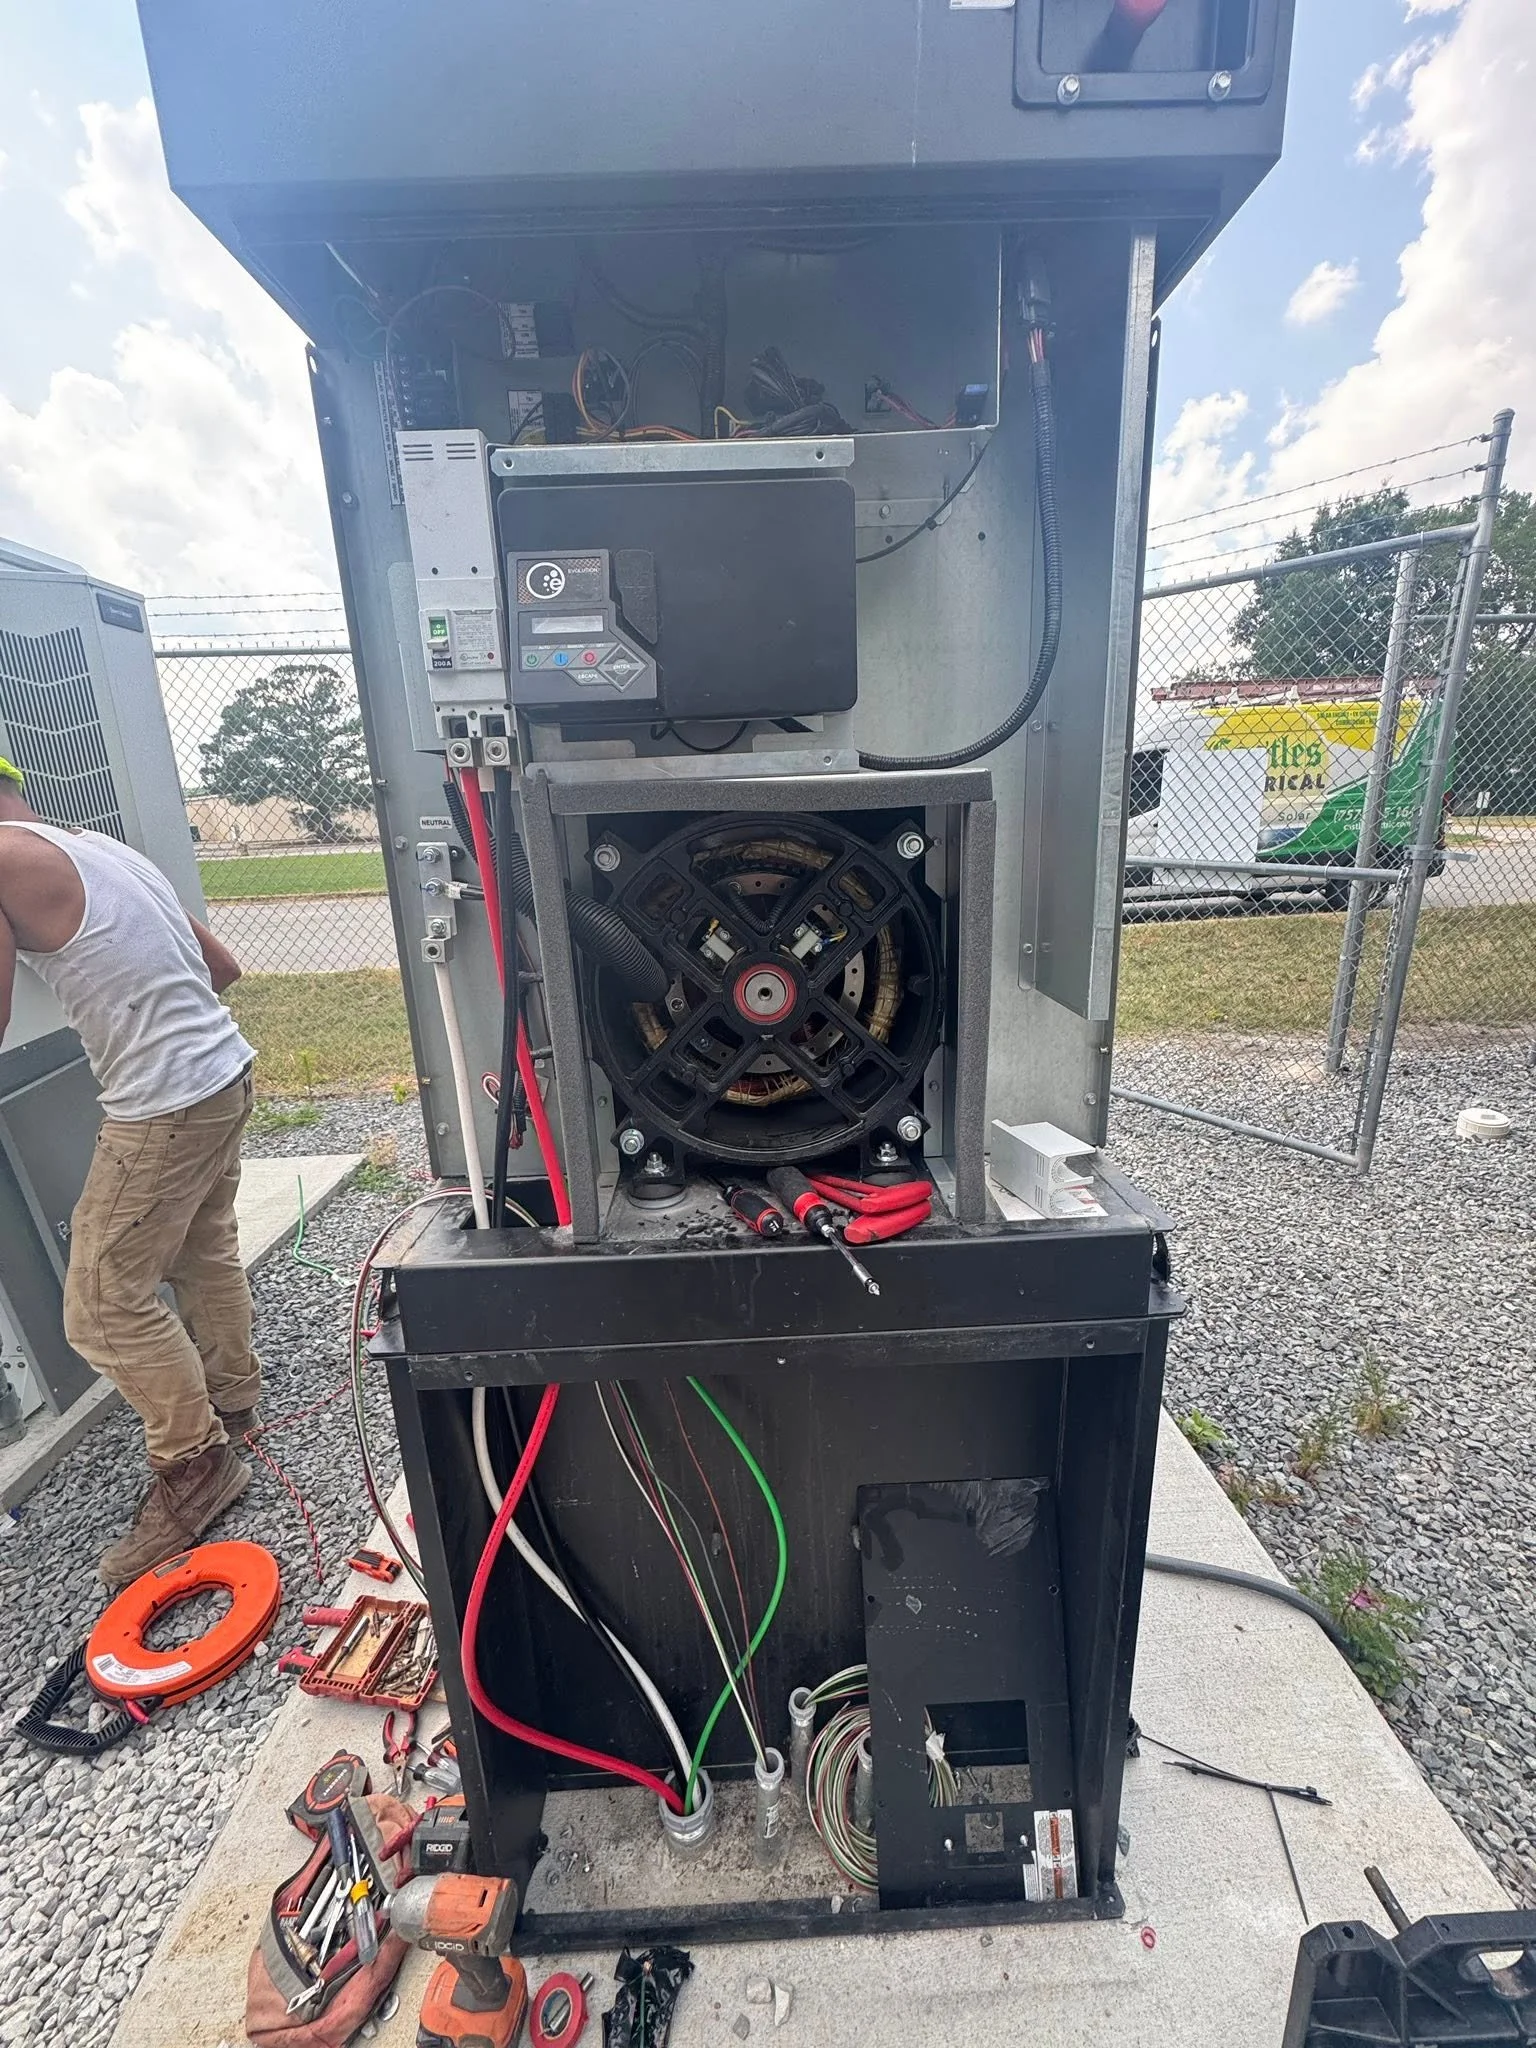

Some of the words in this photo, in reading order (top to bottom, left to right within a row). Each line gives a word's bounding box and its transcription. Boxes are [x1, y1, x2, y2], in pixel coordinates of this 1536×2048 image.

[1264, 774, 1325, 792] RICAL
[1278, 812, 1311, 822] Solar
[426, 1843, 453, 1853] RIDGID
[426, 1941, 465, 1951] IDGID
